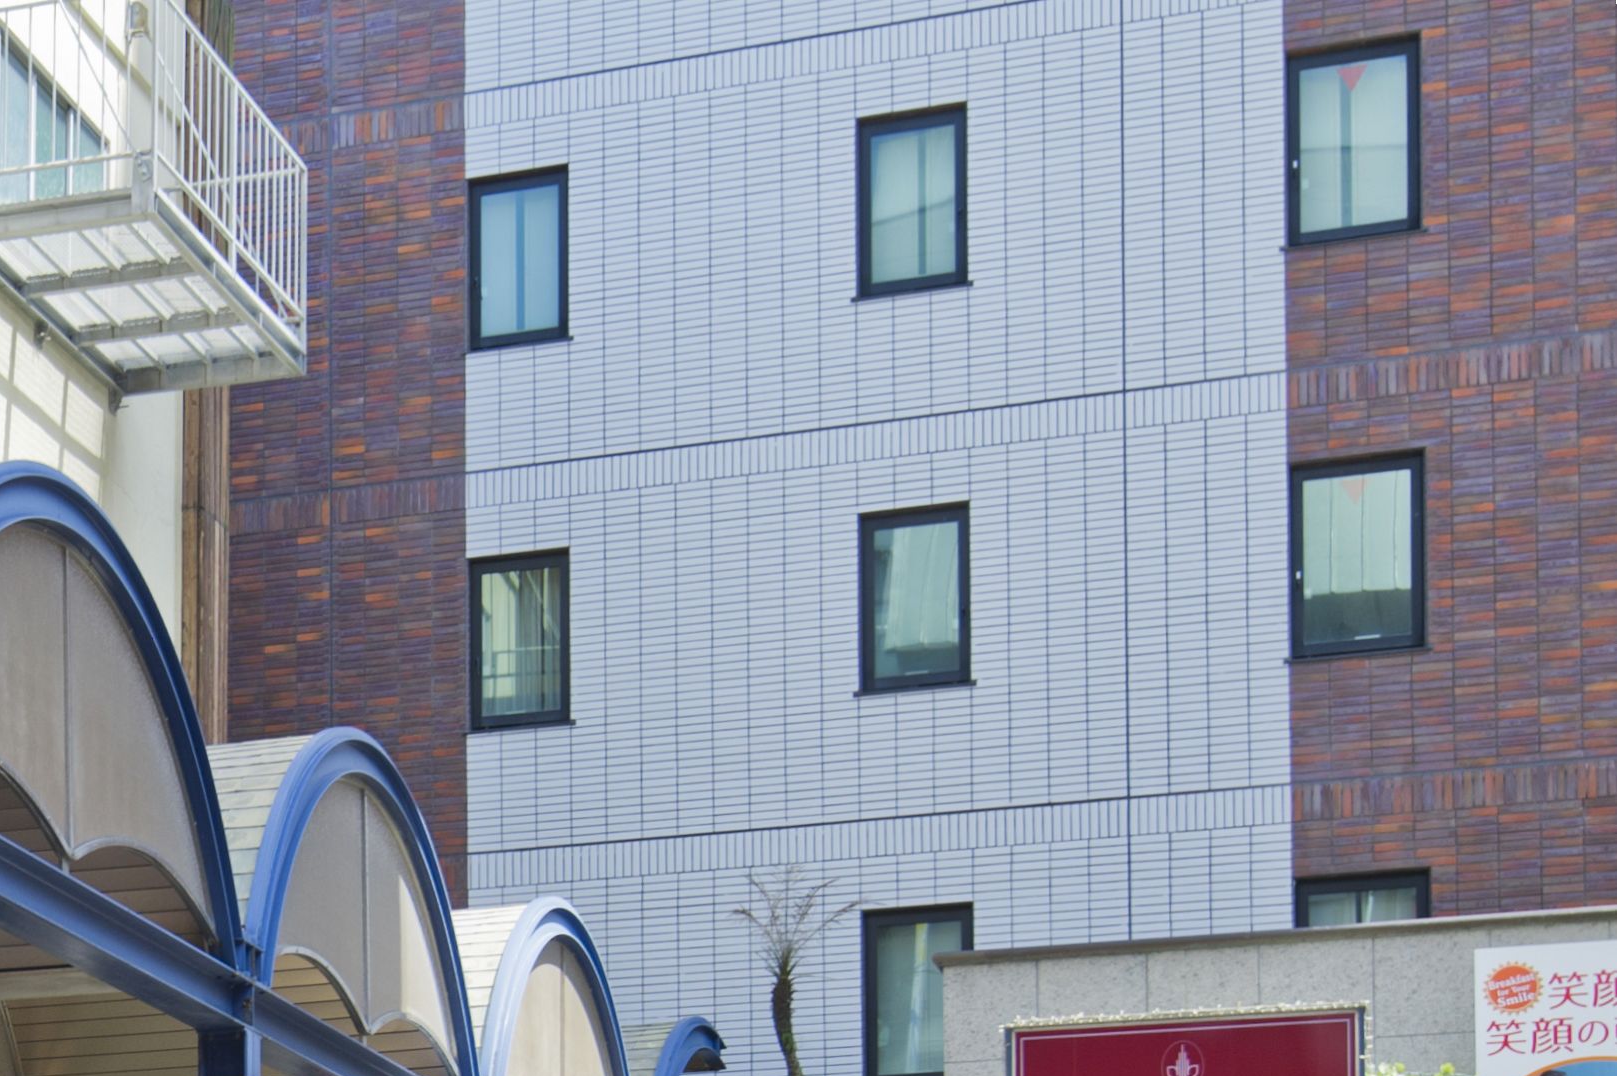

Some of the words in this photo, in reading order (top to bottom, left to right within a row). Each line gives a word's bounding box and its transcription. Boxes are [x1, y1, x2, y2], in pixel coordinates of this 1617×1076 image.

[1495, 992, 1536, 1009] Smile
[1486, 1017, 1617, 1056] 笑顔の
